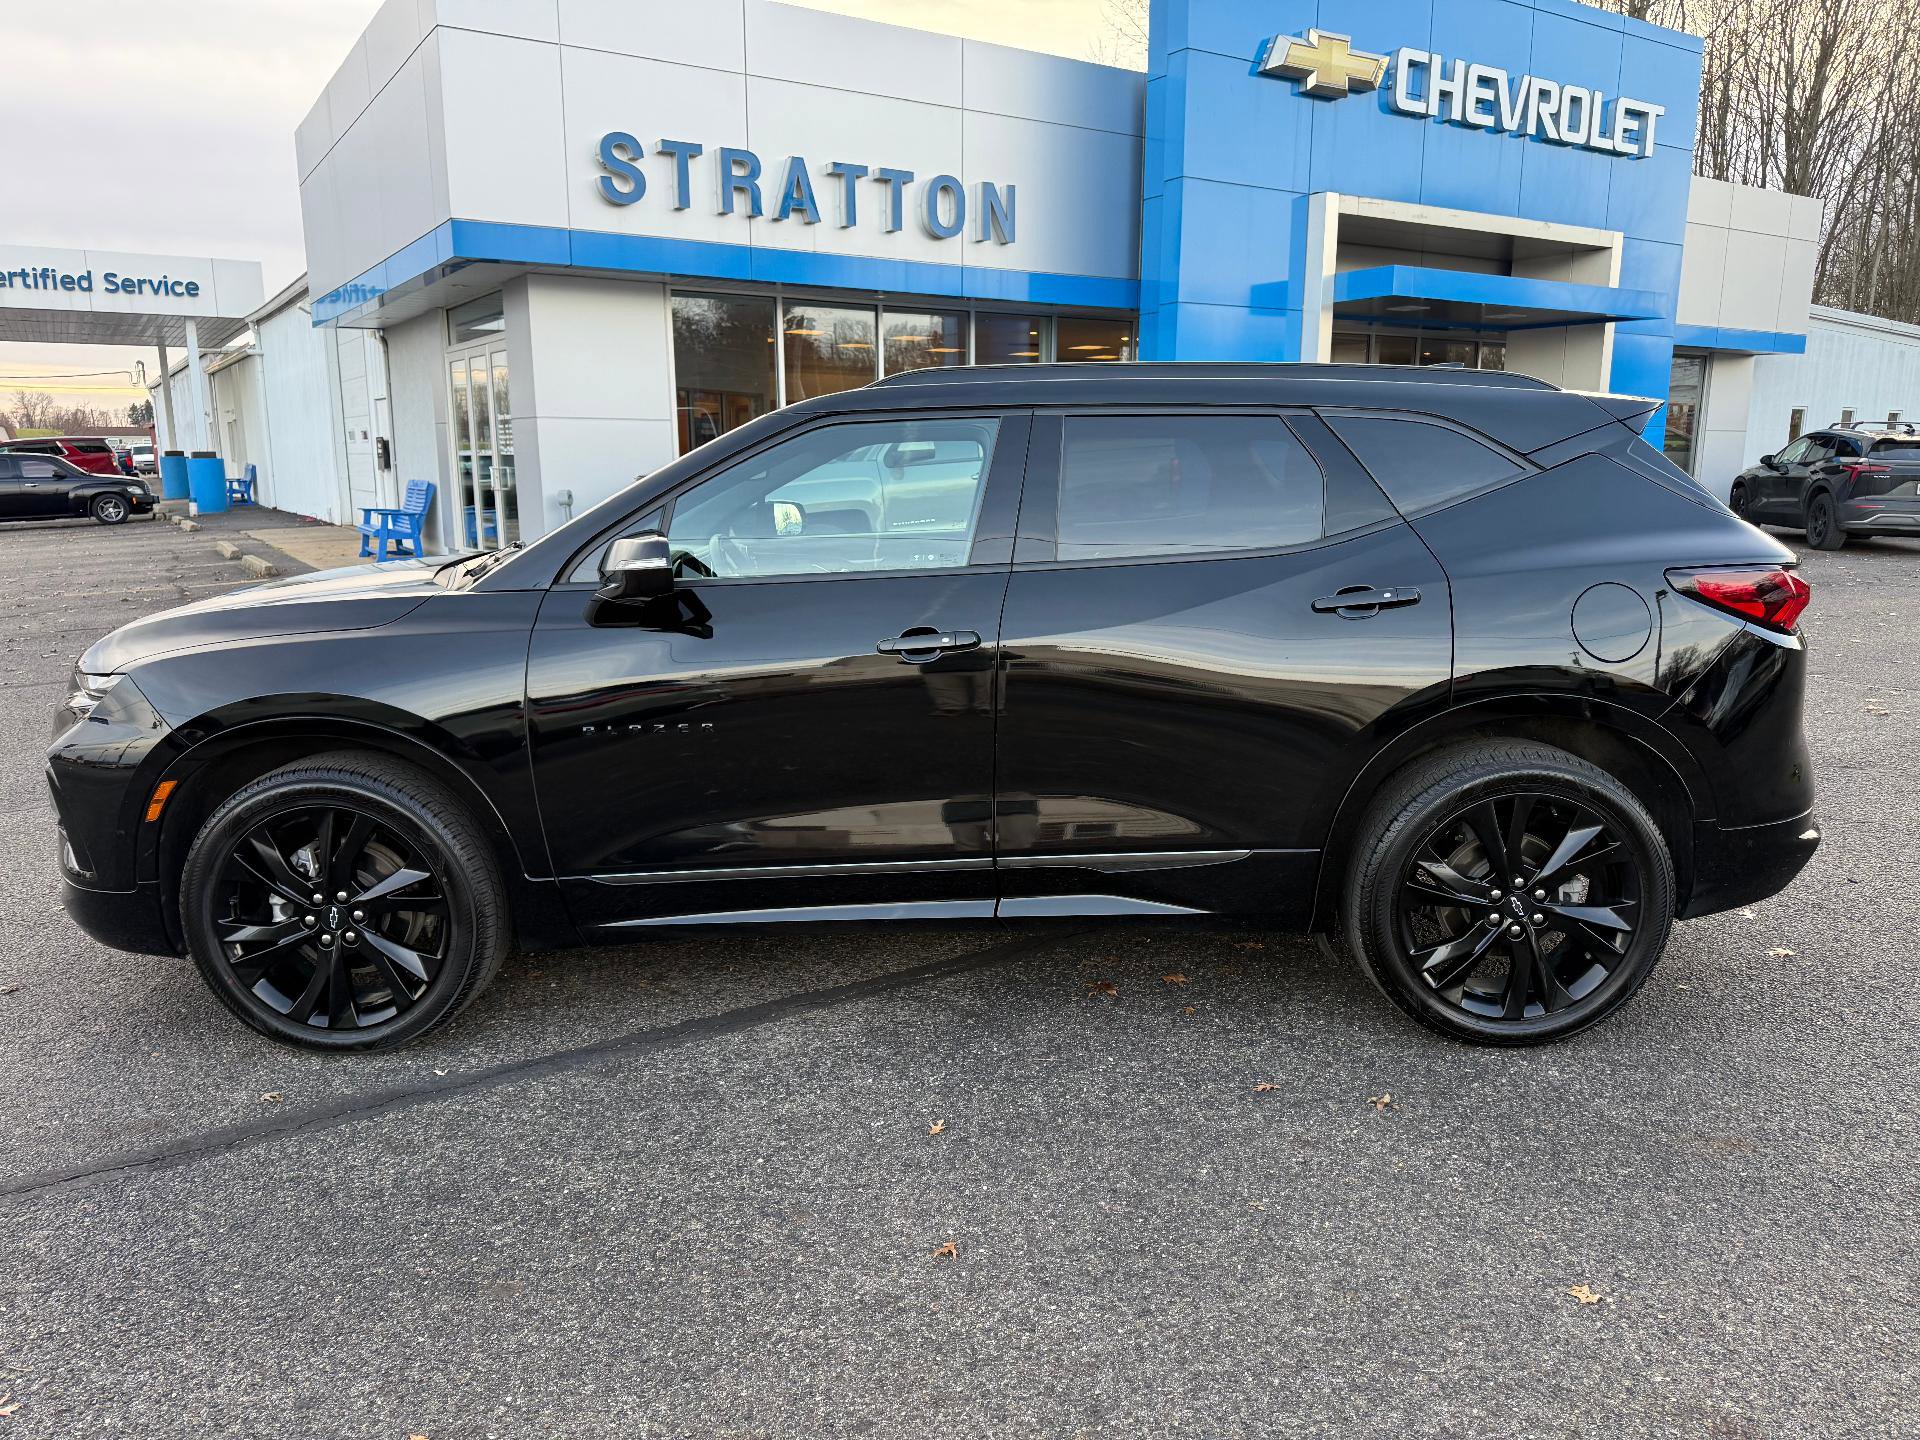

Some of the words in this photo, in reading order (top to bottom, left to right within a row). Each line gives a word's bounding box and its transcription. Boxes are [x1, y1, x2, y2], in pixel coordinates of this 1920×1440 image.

[1389, 46, 1665, 158] CHEVROLET
[595, 131, 1016, 245] STRATTON
[103, 272, 200, 297] Service
